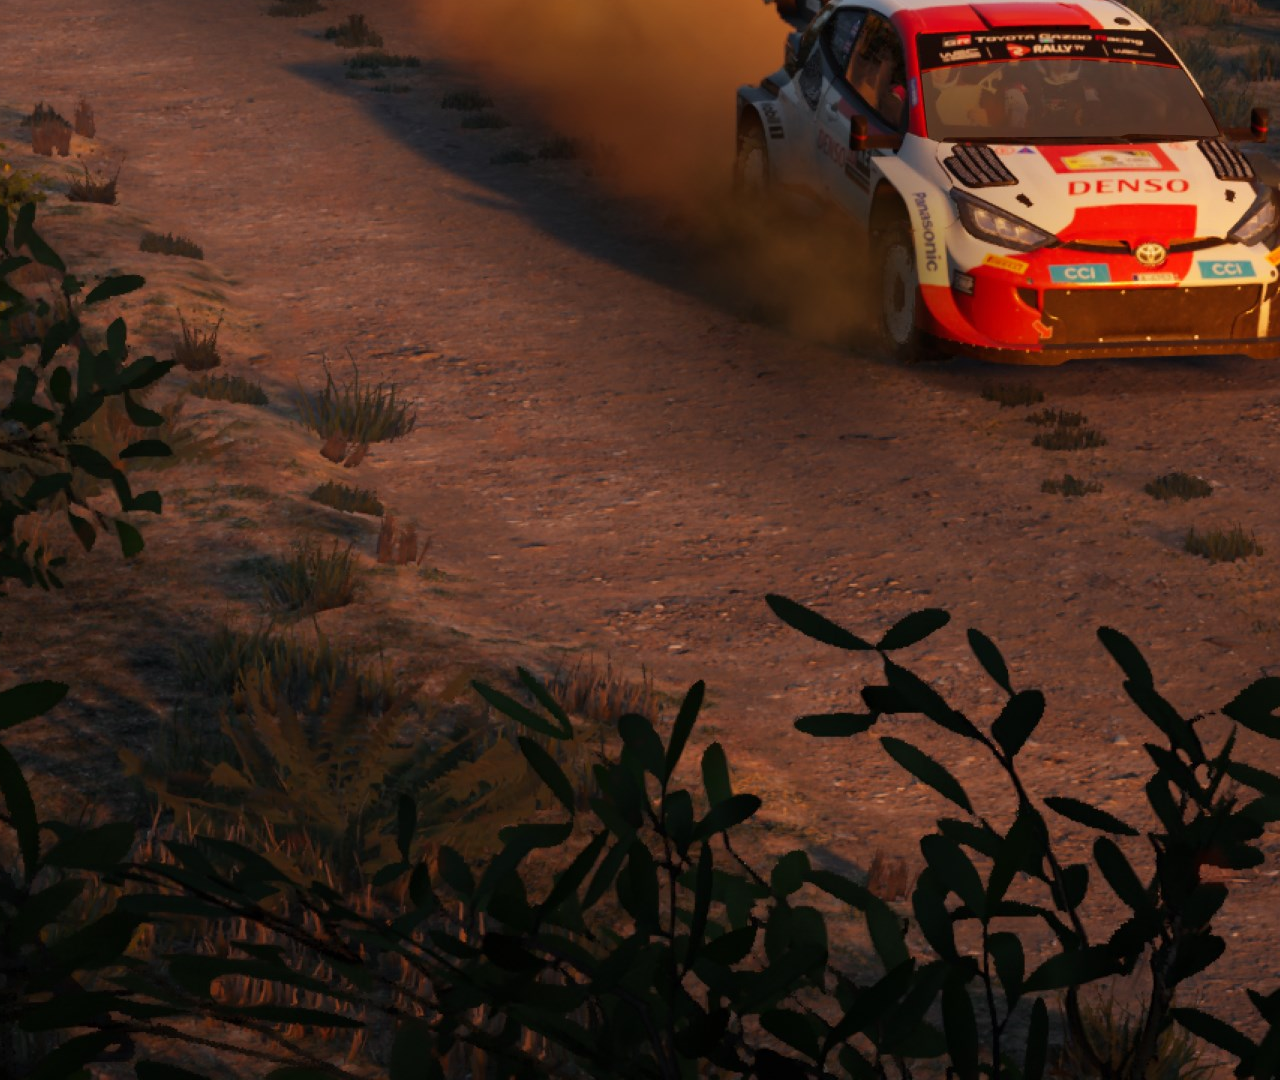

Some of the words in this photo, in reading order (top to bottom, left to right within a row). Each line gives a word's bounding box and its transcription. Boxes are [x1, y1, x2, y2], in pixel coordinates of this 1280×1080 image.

[975, 34, 1036, 43] TOYOTA
[1032, 44, 1072, 54] RALLY
[1067, 178, 1190, 197] DENSO
[912, 191, 942, 272] Panasonic
[1063, 266, 1096, 280] CCI
[1210, 262, 1243, 276] CCI
